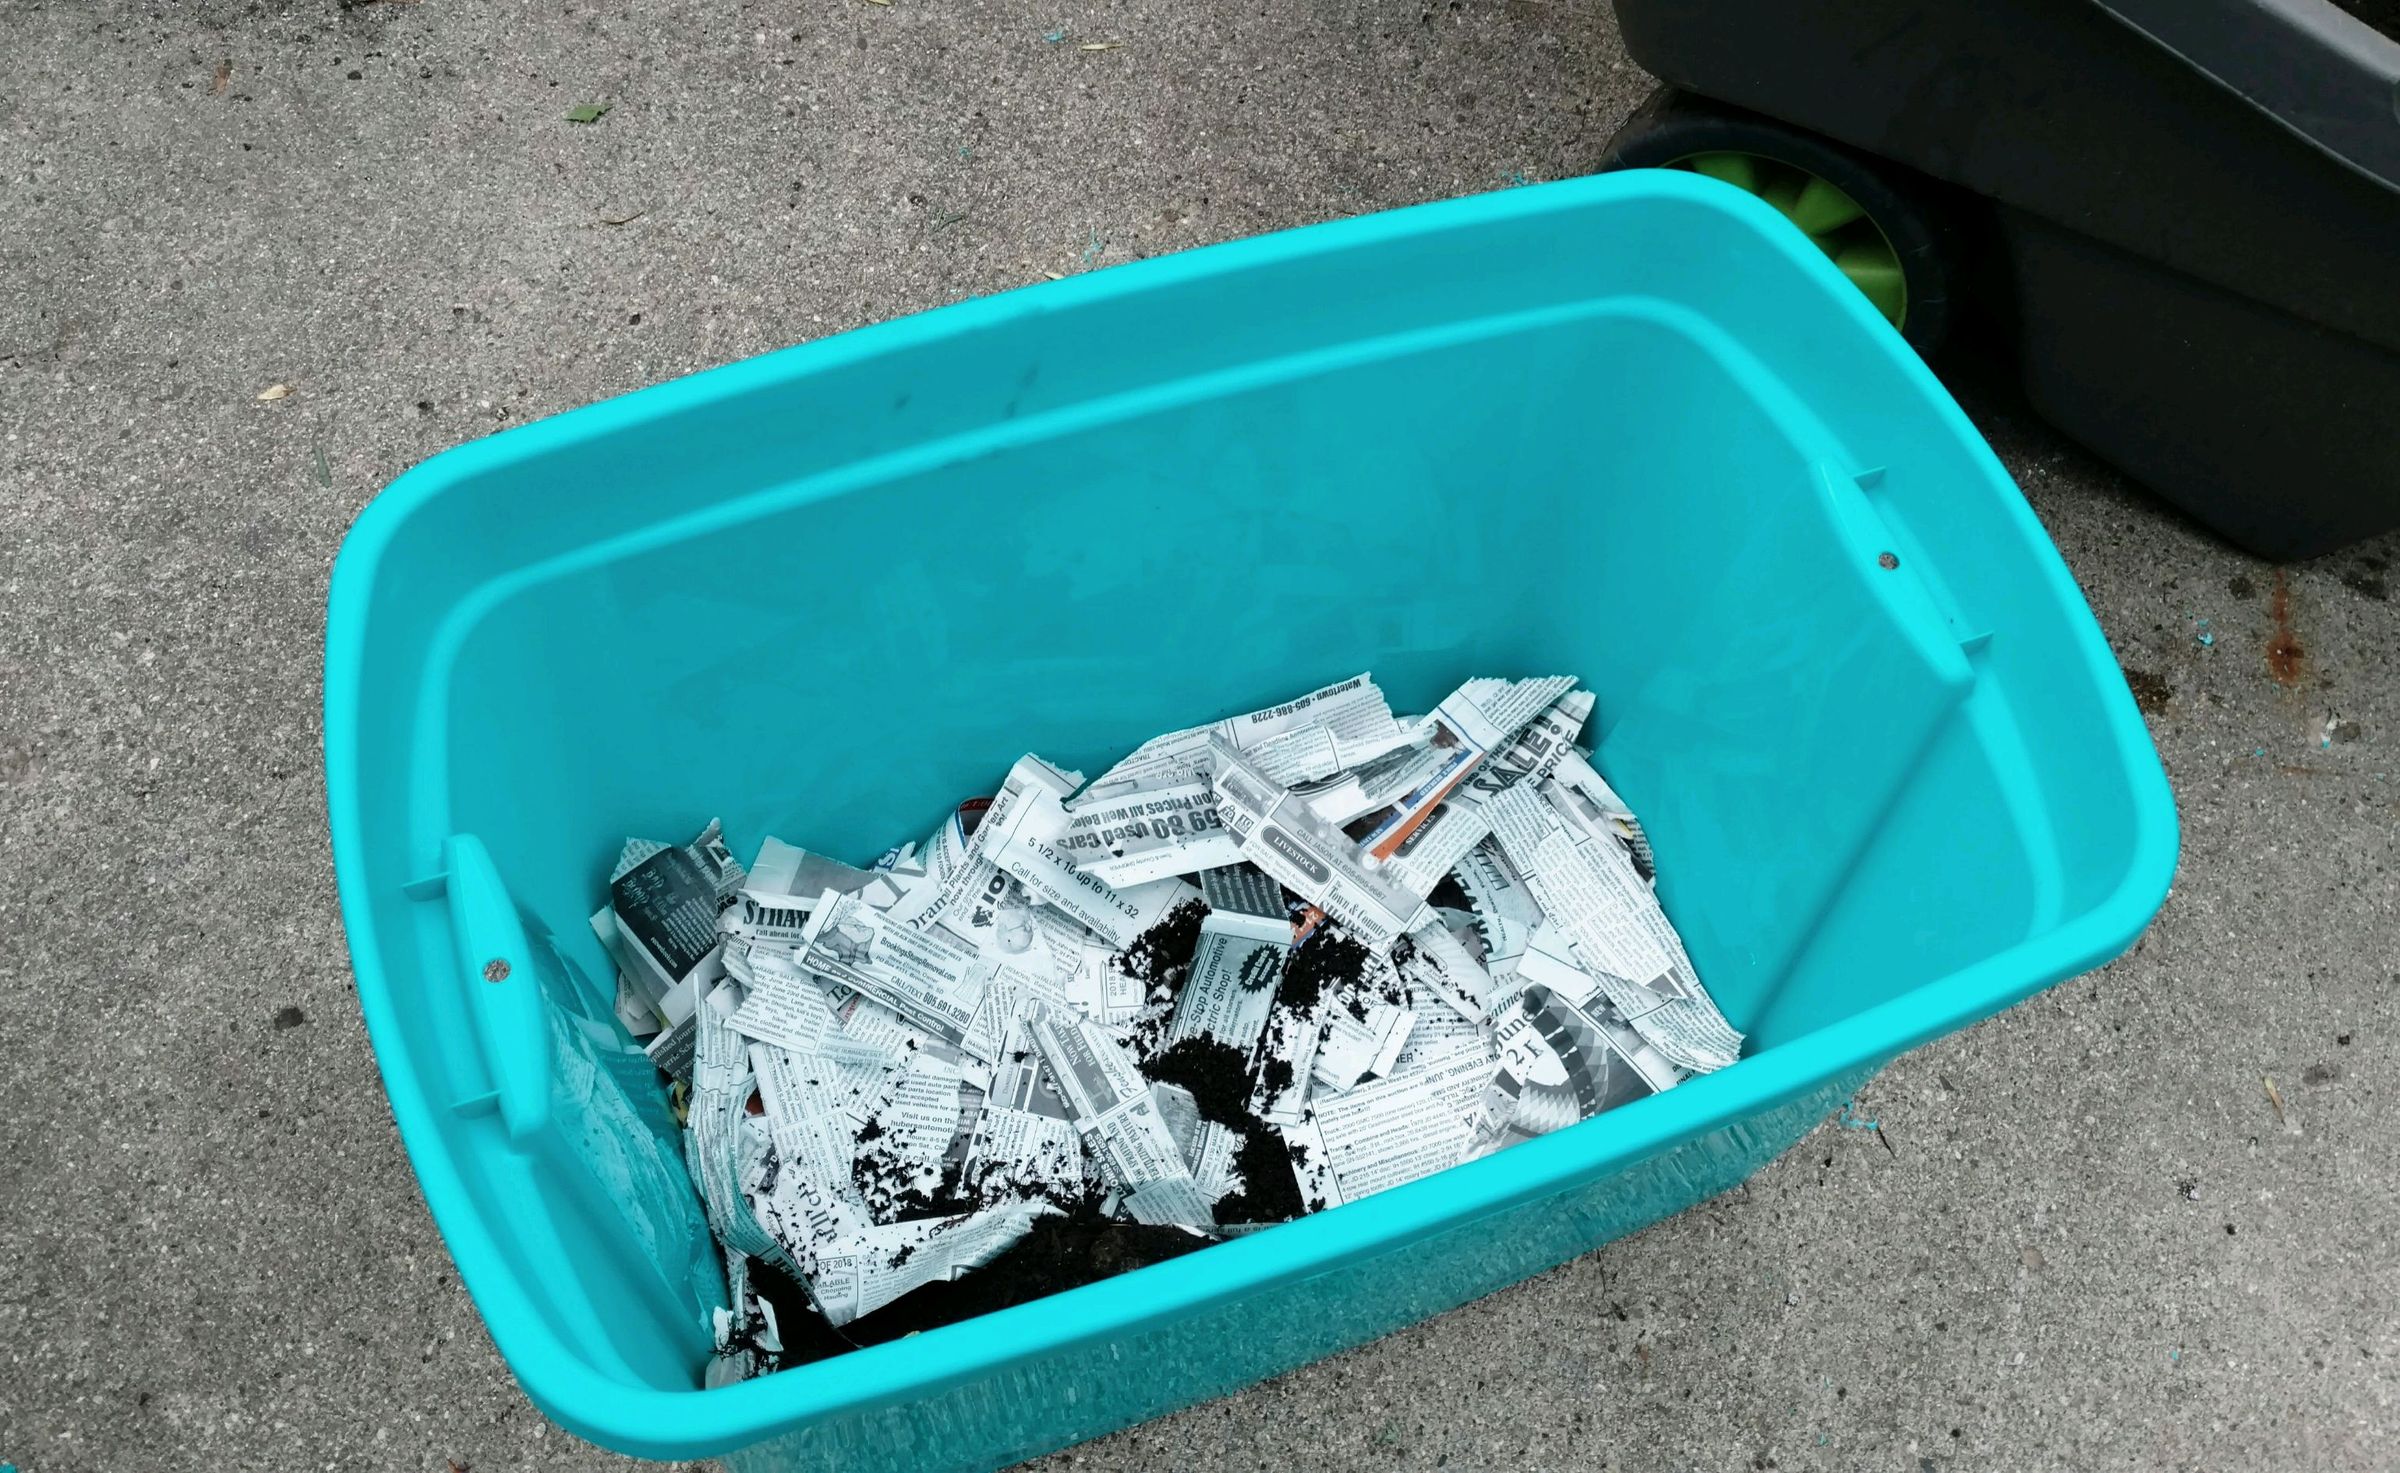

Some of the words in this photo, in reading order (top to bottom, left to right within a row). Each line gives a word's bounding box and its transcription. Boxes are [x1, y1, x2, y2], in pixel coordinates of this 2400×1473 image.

[1315, 678, 1361, 700] Watertown
[1250, 697, 1311, 724] 605-886-2228
[1471, 713, 1562, 801] SALE!
[1477, 759, 1491, 773] OF
[1488, 743, 1507, 761] THE
[1537, 729, 1575, 778] PRICE
[1099, 806, 1127, 824] Well
[1128, 803, 1144, 818] All
[947, 860, 972, 888] Plants
[965, 843, 982, 861] and
[995, 796, 1010, 811] Art
[1055, 830, 1099, 856] Cars
[1271, 835, 1320, 874] LIVESTOCK
[1295, 828, 1313, 844] CALL
[1311, 841, 1334, 860] JASON
[1332, 858, 1342, 867] AT
[1010, 860, 1031, 878] Call
[1029, 873, 1044, 888] for
[1042, 884, 1060, 900] size
[1060, 895, 1079, 913] and
[1027, 836, 1037, 847] 5
[1036, 842, 1054, 859] 1/2
[1053, 856, 1062, 865] x
[1062, 860, 1077, 875] 10
[1074, 871, 1091, 888] up
[1090, 881, 1104, 894] to
[1103, 889, 1116, 903] 11
[1116, 900, 1125, 909] x
[1123, 903, 1140, 919] 32
[948, 886, 965, 906] now
[951, 901, 966, 917] Our
[1326, 886, 1352, 910] Town
[1347, 902, 1360, 916] &
[881, 924, 894, 934] WITH
[892, 930, 907, 941] BLACK
[878, 936, 958, 983] BrookingsStumpRemoval.com
[805, 954, 831, 973] HOME
[898, 1001, 917, 1016] Pest
[915, 1011, 945, 1032] Control
[1108, 975, 1116, 995] 2018
[1187, 996, 1208, 1040] ne-Stop
[1198, 936, 1227, 994] Automotive
[888, 974, 925, 1000] CALL/TEXT
[920, 991, 971, 1024] 605.691.3280
[1204, 1002, 1221, 1032] ctric
[1213, 968, 1232, 1002] Shop!
[1223, 988, 1239, 1013] starters
[1066, 1026, 1087, 1051] FIELD
[1063, 1043, 1082, 1066] NOW
[1444, 1057, 1483, 1077] EVENING,
[1445, 1082, 1460, 1091] AND
[1459, 1070, 1494, 1086] ACHINERY
[901, 1111, 918, 1120] Visit
[1115, 1111, 1140, 1143] PASTURE
[1378, 1129, 1390, 1137] and
[1082, 1131, 1107, 1164] SALES
[1093, 1131, 1117, 1166] 690-1655
[1366, 1161, 1378, 1169] and
[1099, 1160, 1127, 1199] LOOMIS
[819, 1260, 831, 1270] OF
[816, 1277, 850, 1288] AILABLE
